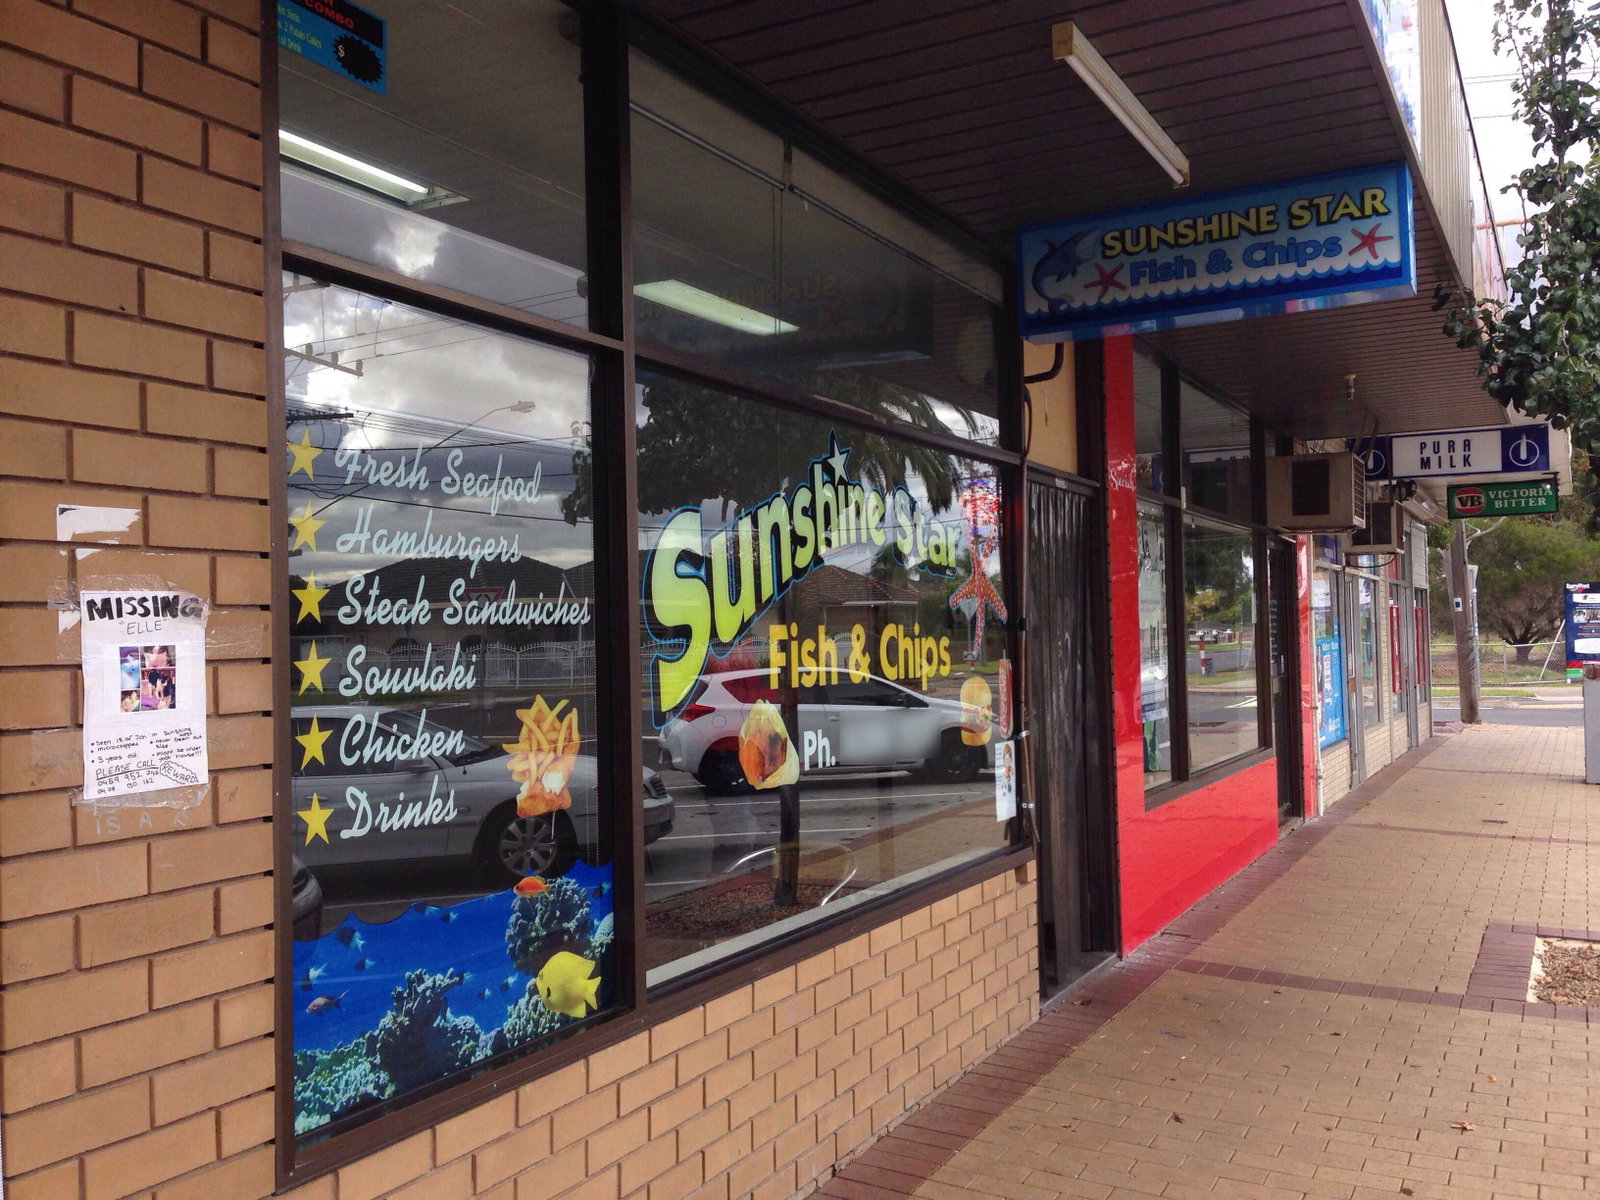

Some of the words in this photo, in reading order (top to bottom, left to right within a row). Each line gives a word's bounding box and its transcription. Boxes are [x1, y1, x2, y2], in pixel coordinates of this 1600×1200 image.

[338, 44, 345, 58] $
[1102, 205, 1278, 260] SUNSHINE
[1288, 187, 1391, 229] STAR
[1129, 254, 1196, 288] Fish
[1206, 248, 1234, 275] &
[1242, 236, 1342, 270] Chips
[1419, 438, 1472, 456] PURA
[1419, 454, 1472, 470] MILK
[334, 441, 430, 490] Fresh
[440, 448, 542, 516] Seafood
[1457, 495, 1483, 508] VB
[1488, 488, 1553, 499] VICTORIA
[1494, 497, 1547, 509] BITTER
[336, 503, 522, 579] Hamburgers
[647, 432, 887, 713] Sunshine
[893, 486, 961, 569] Star
[86, 594, 203, 622] MISSING
[337, 573, 431, 627] Steak
[442, 577, 591, 627] Sandwiches
[338, 642, 477, 698] Souvlaki
[768, 624, 839, 690] Fish
[848, 622, 872, 685] &
[879, 621, 951, 691] Chips
[339, 708, 466, 767] Chicken
[803, 728, 837, 771] Ph.
[95, 762, 131, 780] PLEASE
[136, 759, 156, 769] CALL
[340, 774, 458, 840] Drinks
